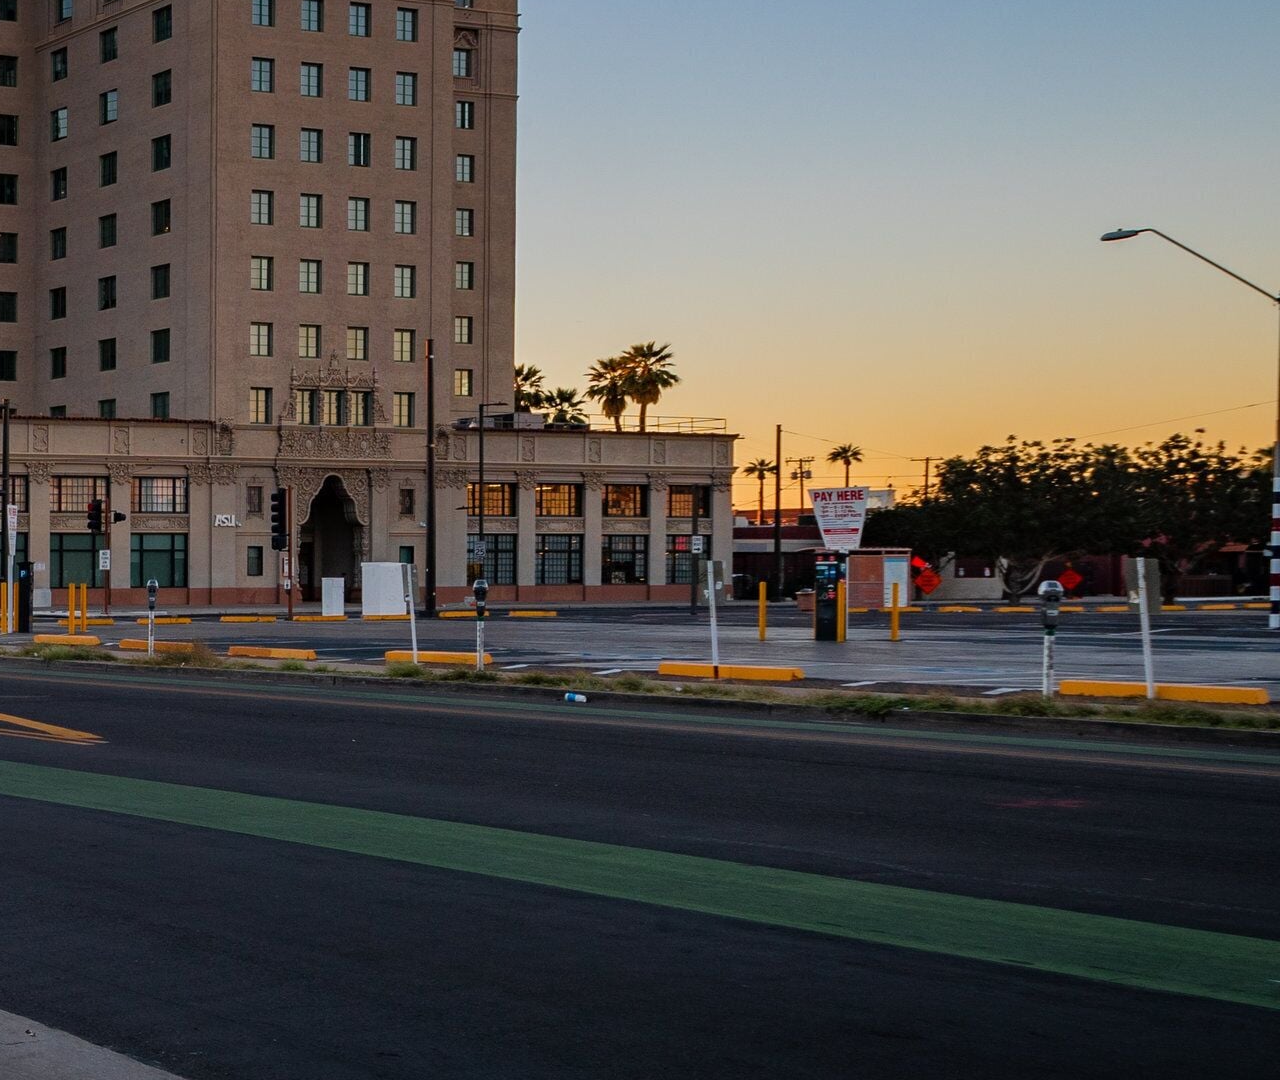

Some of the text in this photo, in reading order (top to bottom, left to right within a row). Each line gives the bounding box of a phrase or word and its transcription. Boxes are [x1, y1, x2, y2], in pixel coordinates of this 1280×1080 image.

[814, 490, 864, 502] PAY HERE
[214, 514, 236, 526] ASU
